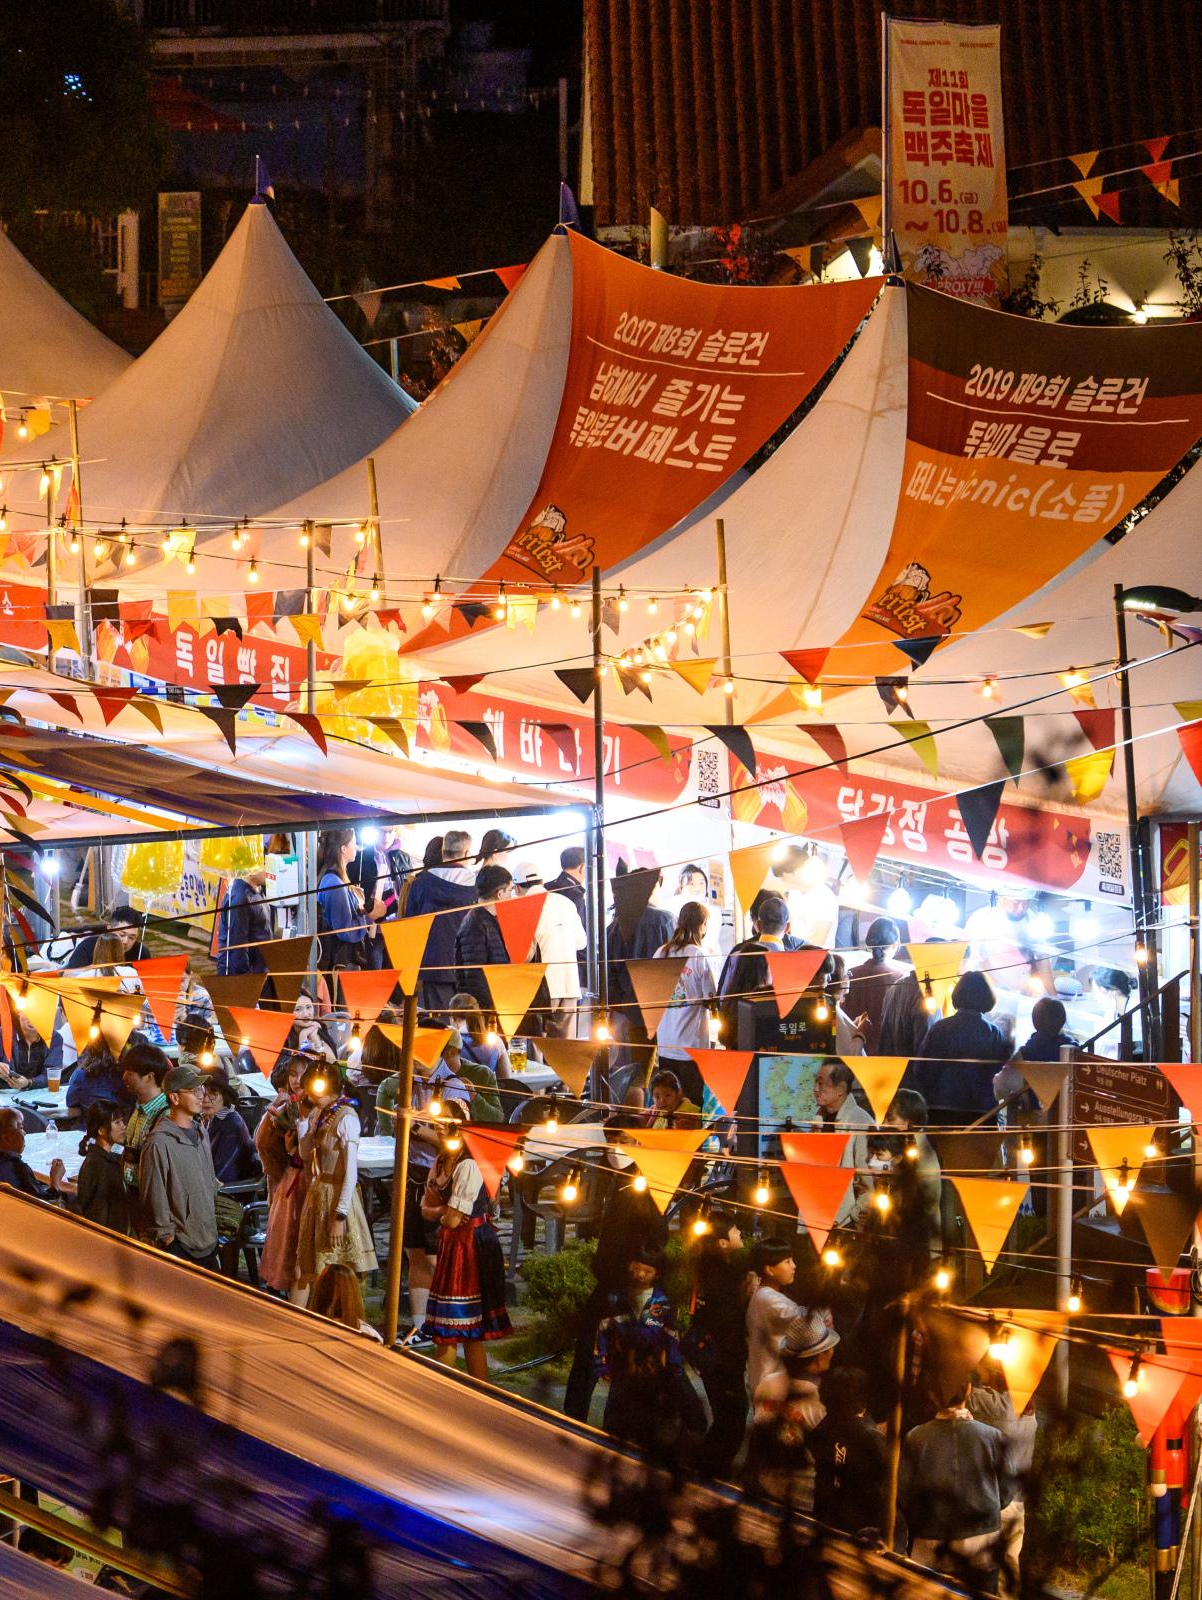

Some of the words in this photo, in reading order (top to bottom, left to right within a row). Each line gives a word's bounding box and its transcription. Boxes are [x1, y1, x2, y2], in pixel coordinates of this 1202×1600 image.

[927, 68, 968, 89] 제11회
[903, 91, 989, 128] 독일마을
[904, 130, 994, 168] 맥주축제
[613, 311, 657, 348] 2017
[648, 323, 702, 359] 제8회
[696, 329, 770, 366] 슬로건
[589, 361, 658, 408] 남해에서
[651, 378, 746, 425] 즐기는
[964, 363, 1015, 401] 2019
[1009, 373, 1071, 408] 제9회
[1065, 376, 1149, 414] 슬로건
[963, 420, 1082, 469] 독일마을로
[779, 1022, 807, 1035] 독일로
[1130, 1071, 1148, 1087] Platz
